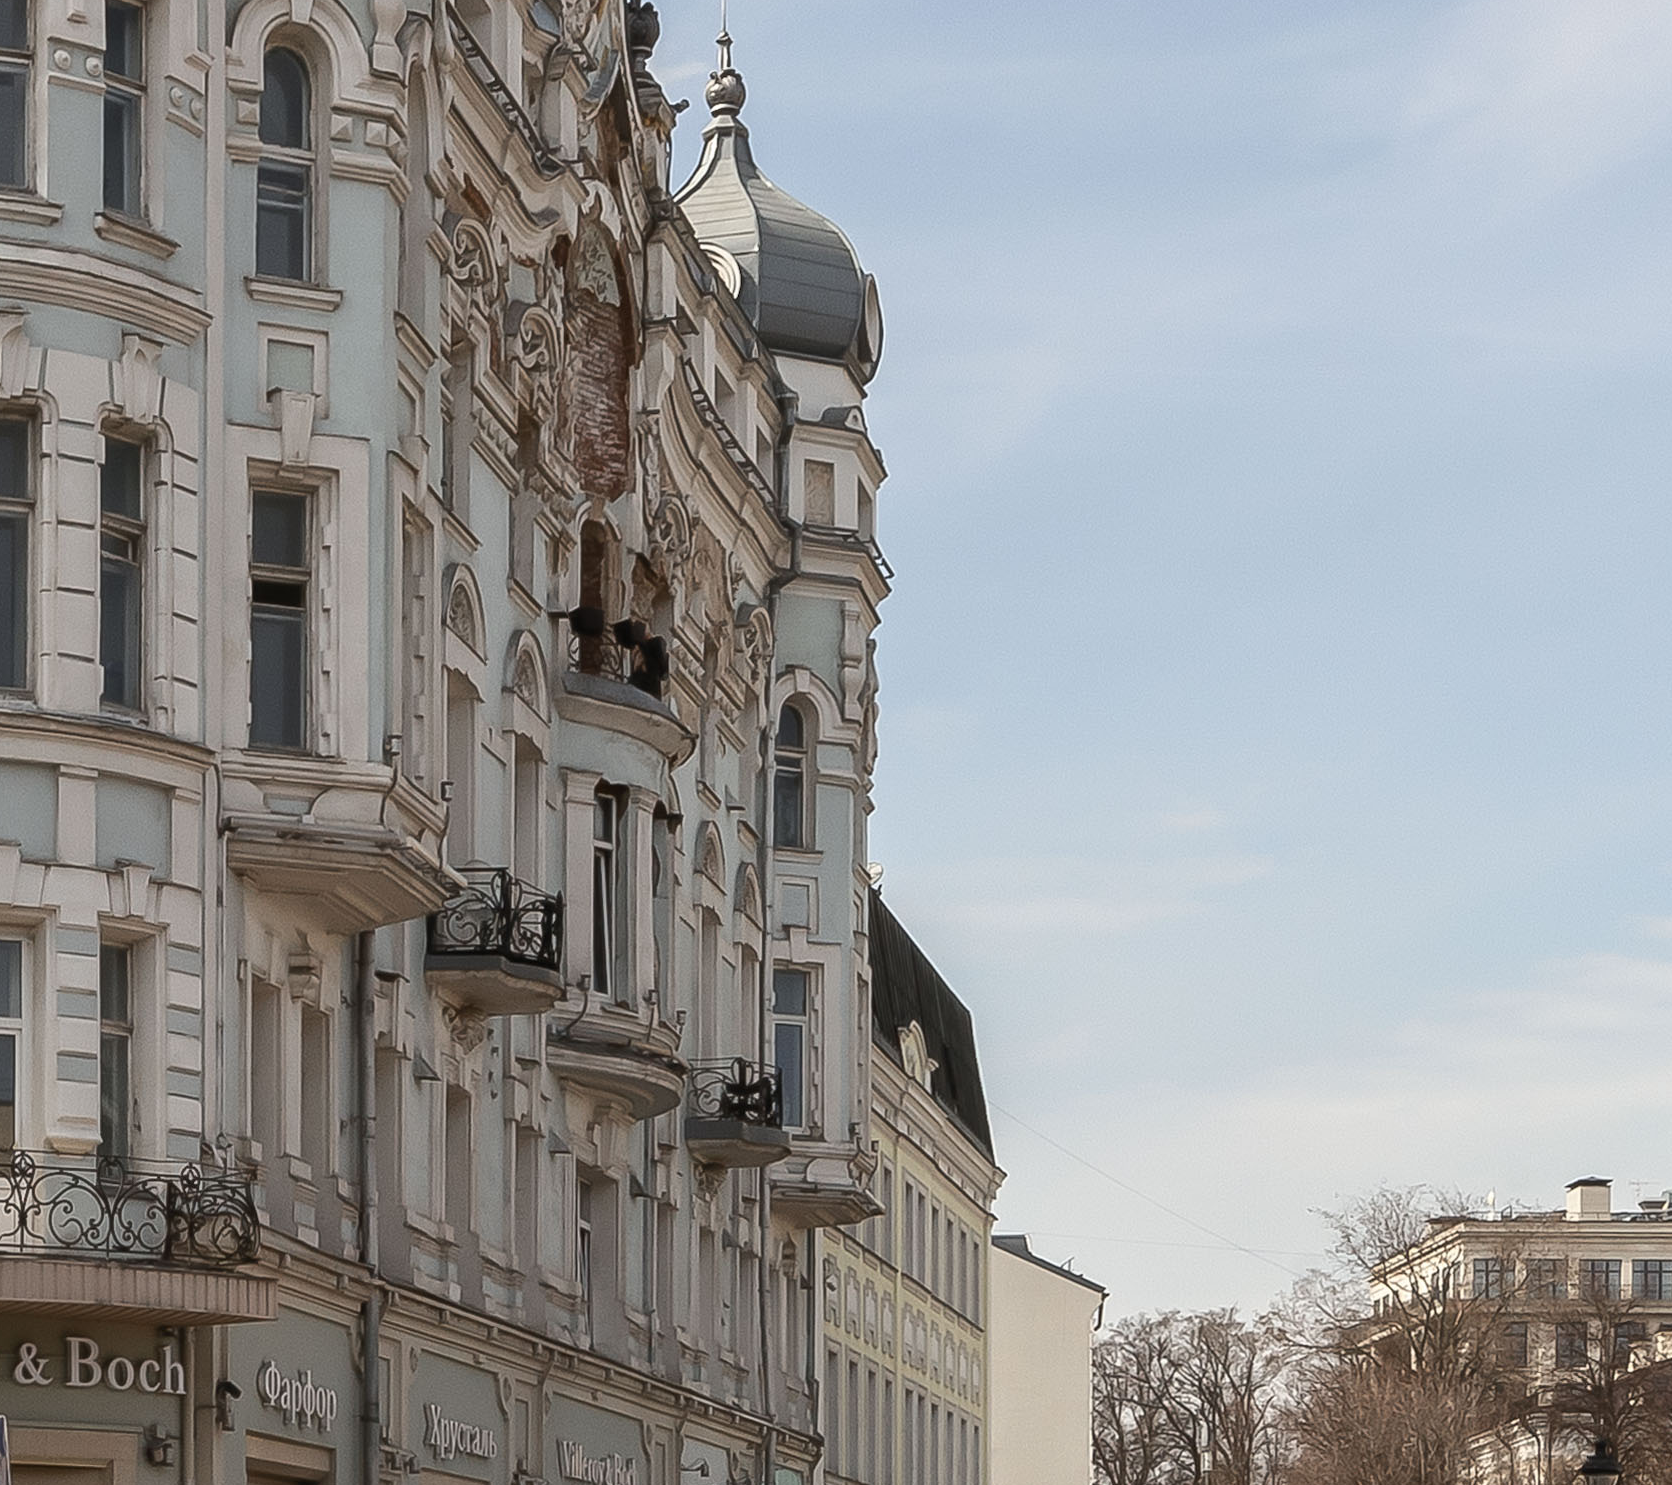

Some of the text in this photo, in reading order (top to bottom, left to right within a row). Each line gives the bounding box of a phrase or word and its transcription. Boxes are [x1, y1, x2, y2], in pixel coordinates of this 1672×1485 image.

[13, 1342, 54, 1386] &
[66, 1336, 188, 1396] Boch
[264, 1360, 338, 1432] Фарфор
[428, 1403, 498, 1461] Хрусталь
